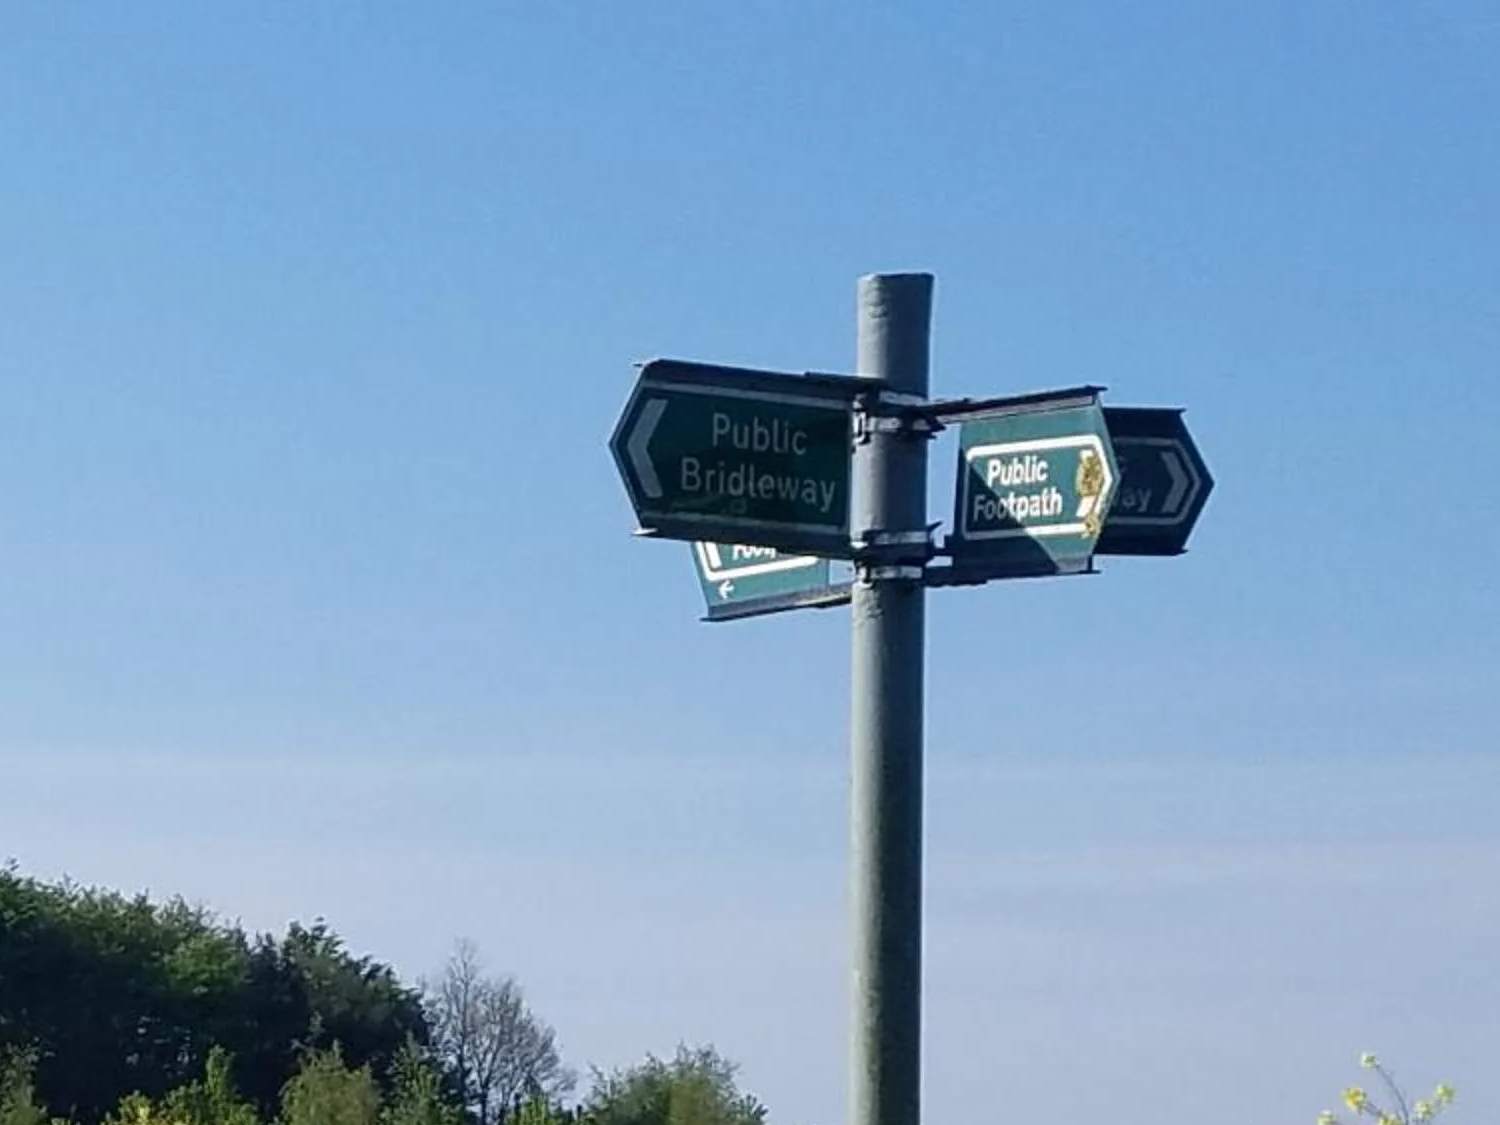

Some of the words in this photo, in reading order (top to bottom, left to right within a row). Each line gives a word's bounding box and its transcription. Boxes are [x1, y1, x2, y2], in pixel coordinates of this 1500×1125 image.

[712, 412, 808, 456] Public
[680, 456, 837, 513] Bridleway
[986, 455, 1049, 487] Public
[972, 487, 1063, 523] Footpath
